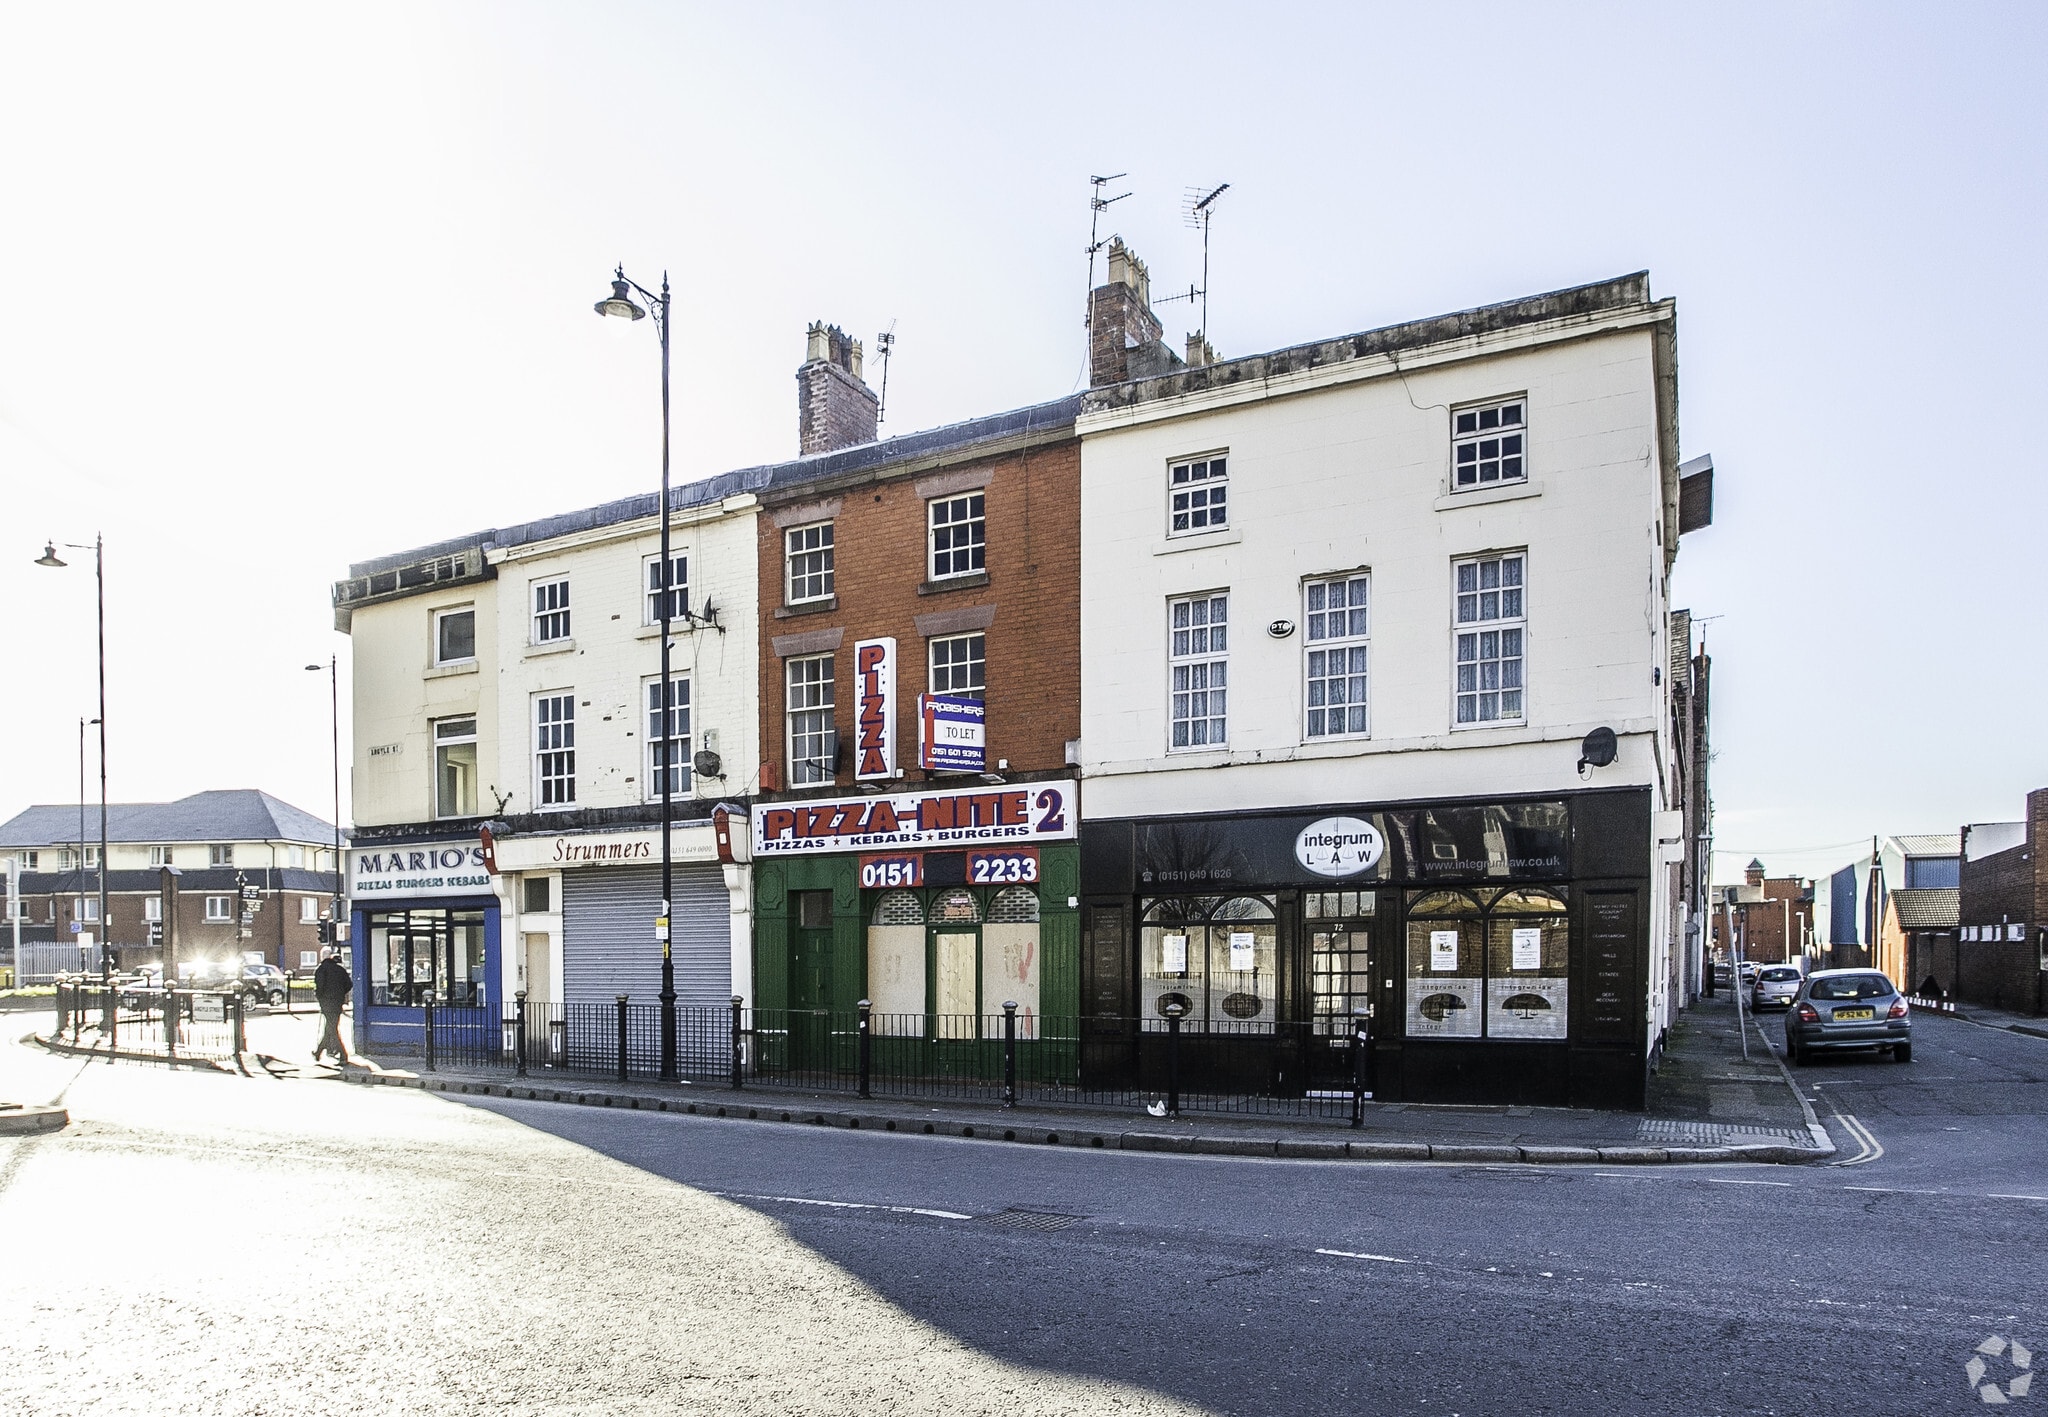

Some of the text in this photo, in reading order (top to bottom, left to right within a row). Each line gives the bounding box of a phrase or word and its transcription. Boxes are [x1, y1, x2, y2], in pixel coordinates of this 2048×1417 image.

[858, 645, 888, 775] PIZZA
[926, 702, 985, 717] FROBISHERS
[946, 727, 976, 740] TO LET
[931, 747, 982, 758] 0151 601 9394
[763, 789, 1064, 840] PIZZA-NITE 2
[764, 826, 1030, 851] PIZZAS KEBABS BURGERS
[1304, 833, 1373, 849] integrum
[553, 838, 650, 862] Strummers
[358, 847, 485, 874] MARIO'S
[1425, 855, 1560, 871] www.integrumlaw.co.uk
[862, 857, 1037, 887] 0151 2233
[1158, 868, 1232, 882] (0151) 649 1626
[357, 874, 490, 891] PIZZAS BURGERS KEBABS
